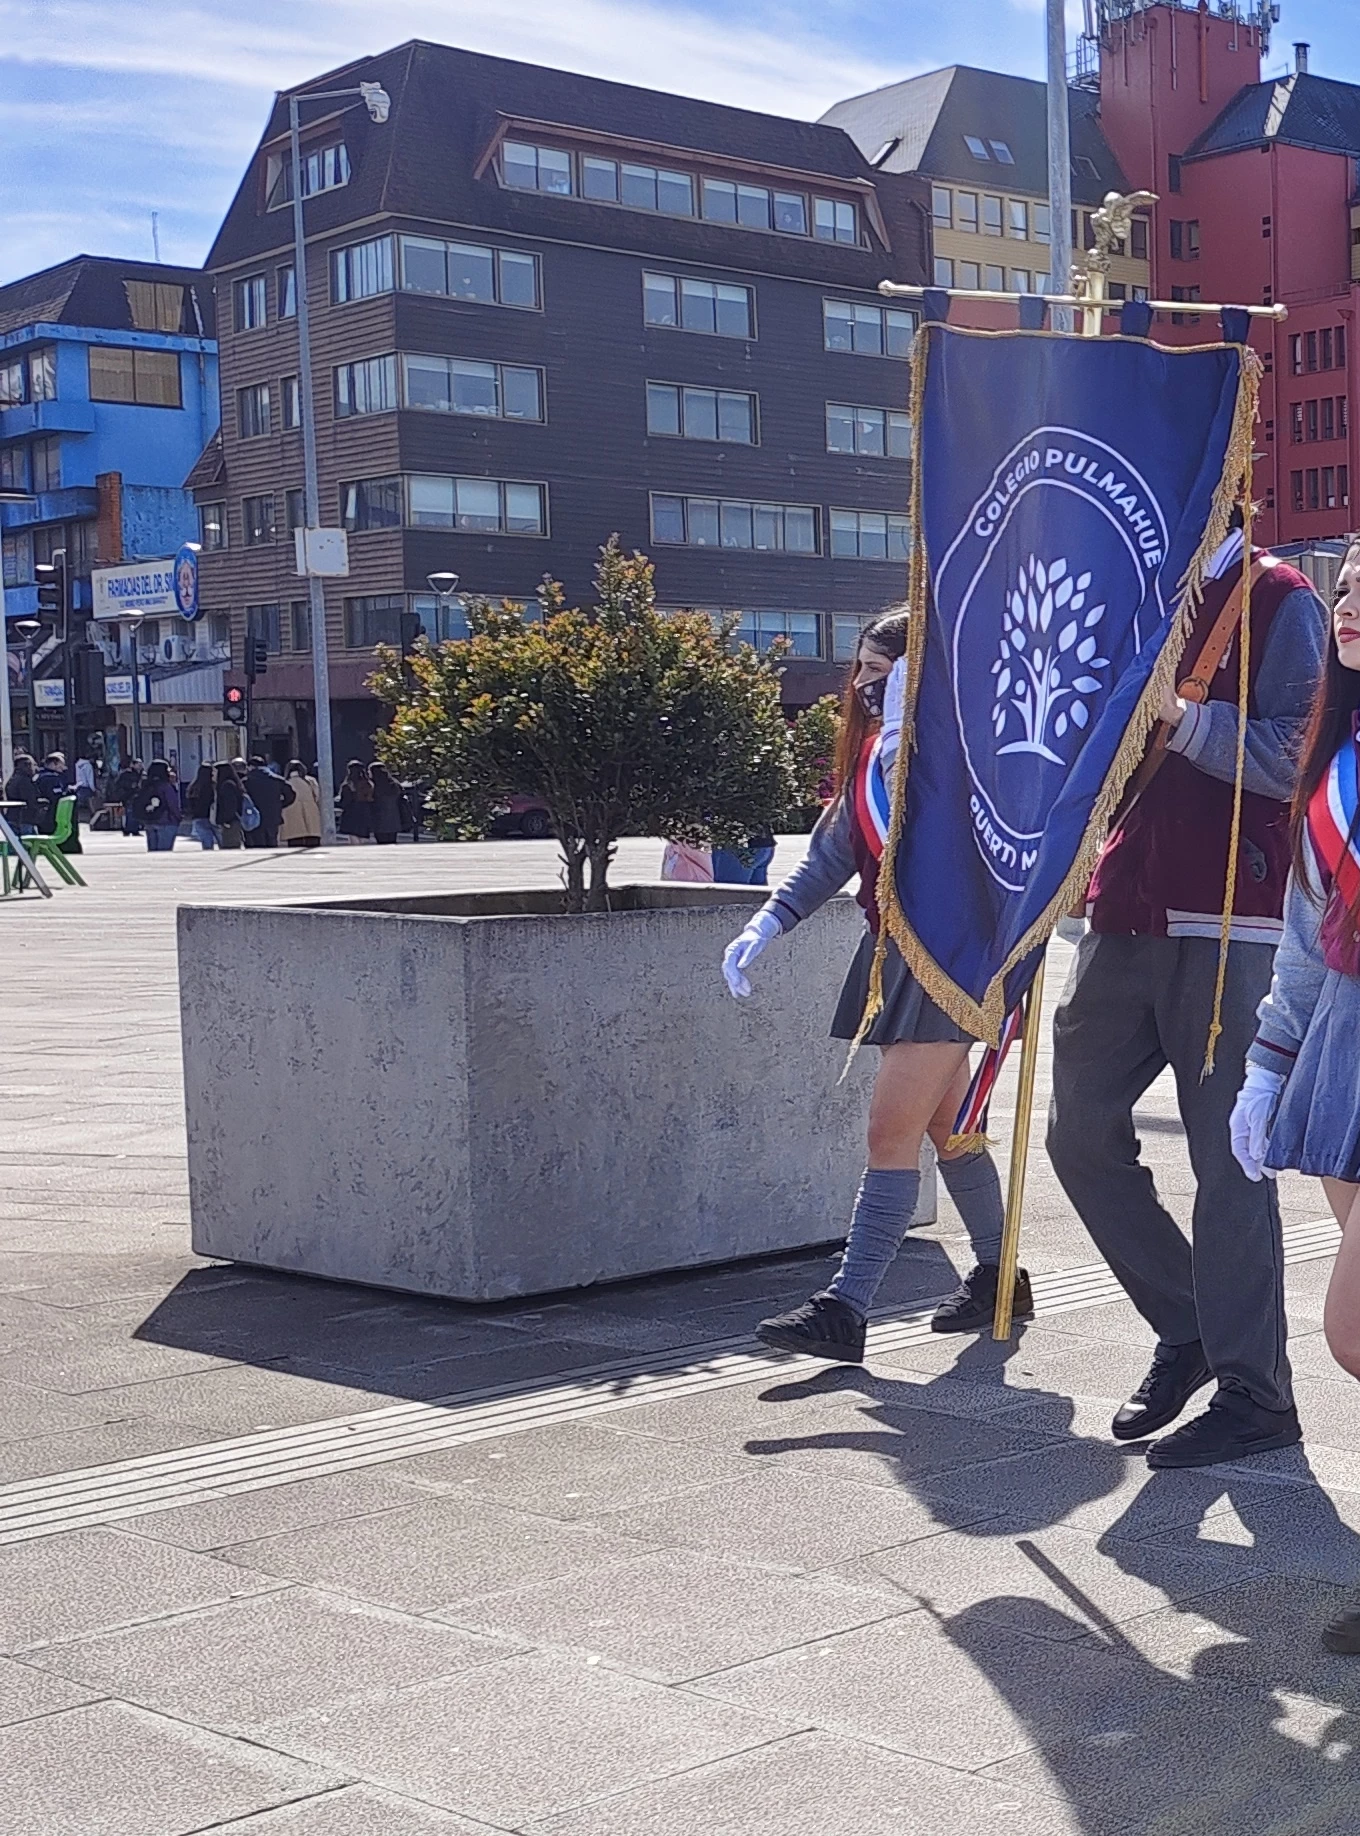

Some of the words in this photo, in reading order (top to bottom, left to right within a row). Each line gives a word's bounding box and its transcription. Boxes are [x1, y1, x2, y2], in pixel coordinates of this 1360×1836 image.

[974, 450, 1040, 537] COLEGIO
[1044, 448, 1162, 569] PULMAHUE
[108, 576, 140, 598] FARMACIAS
